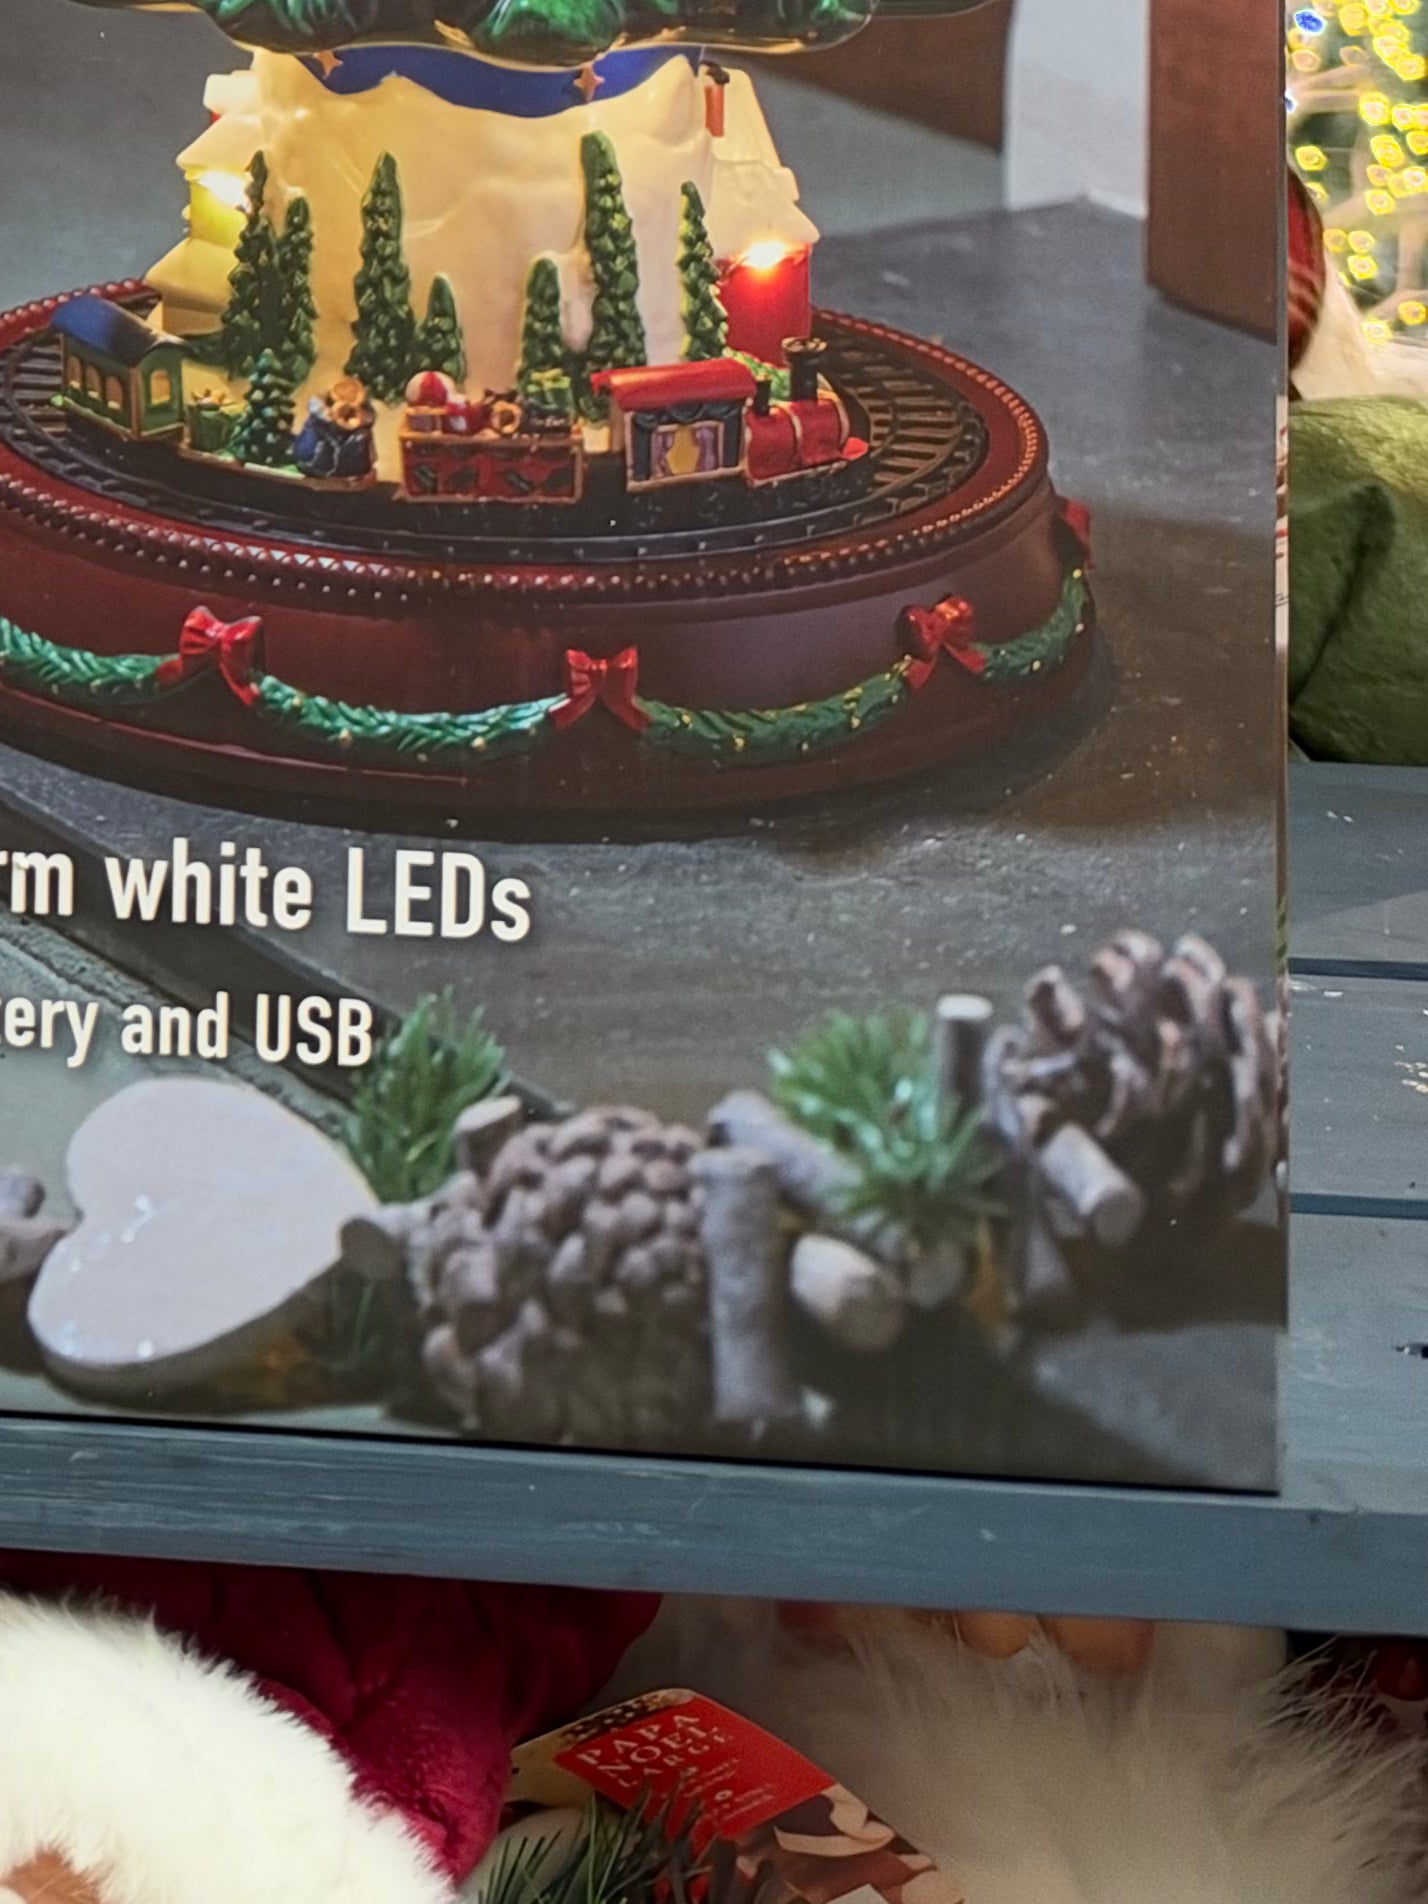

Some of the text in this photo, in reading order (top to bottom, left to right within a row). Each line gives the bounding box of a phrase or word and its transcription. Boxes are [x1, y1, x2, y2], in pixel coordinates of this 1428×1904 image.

[105, 837, 313, 931] white
[347, 846, 532, 942] LEDs
[121, 991, 229, 1059] and
[256, 994, 375, 1067] USB
[576, 1714, 701, 1765] PAPA
[597, 1724, 714, 1778] NOEL
